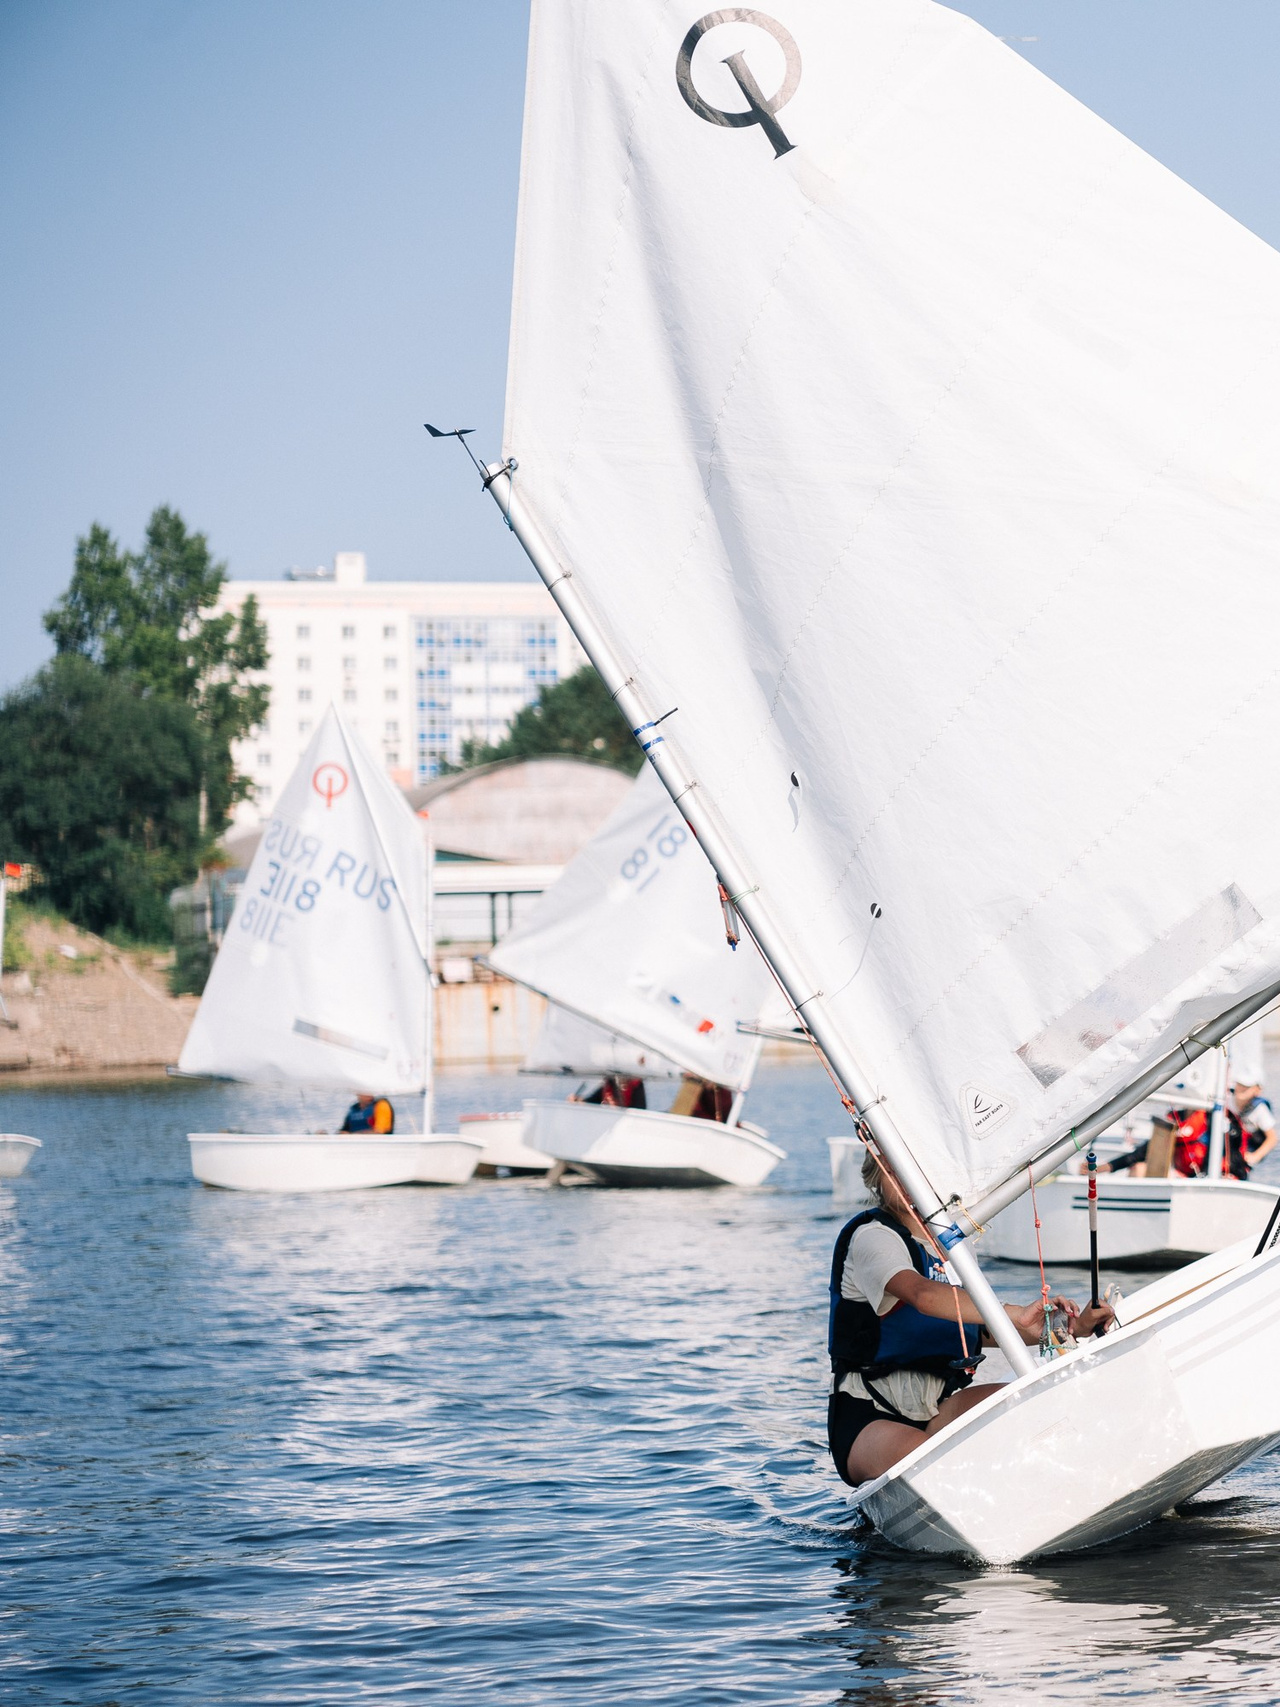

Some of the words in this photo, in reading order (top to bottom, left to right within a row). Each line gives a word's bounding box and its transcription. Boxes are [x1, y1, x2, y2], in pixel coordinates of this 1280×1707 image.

[326, 850, 398, 911] RUS
[982, 1112, 991, 1122] EAST
[991, 1103, 1003, 1115] BOATS
